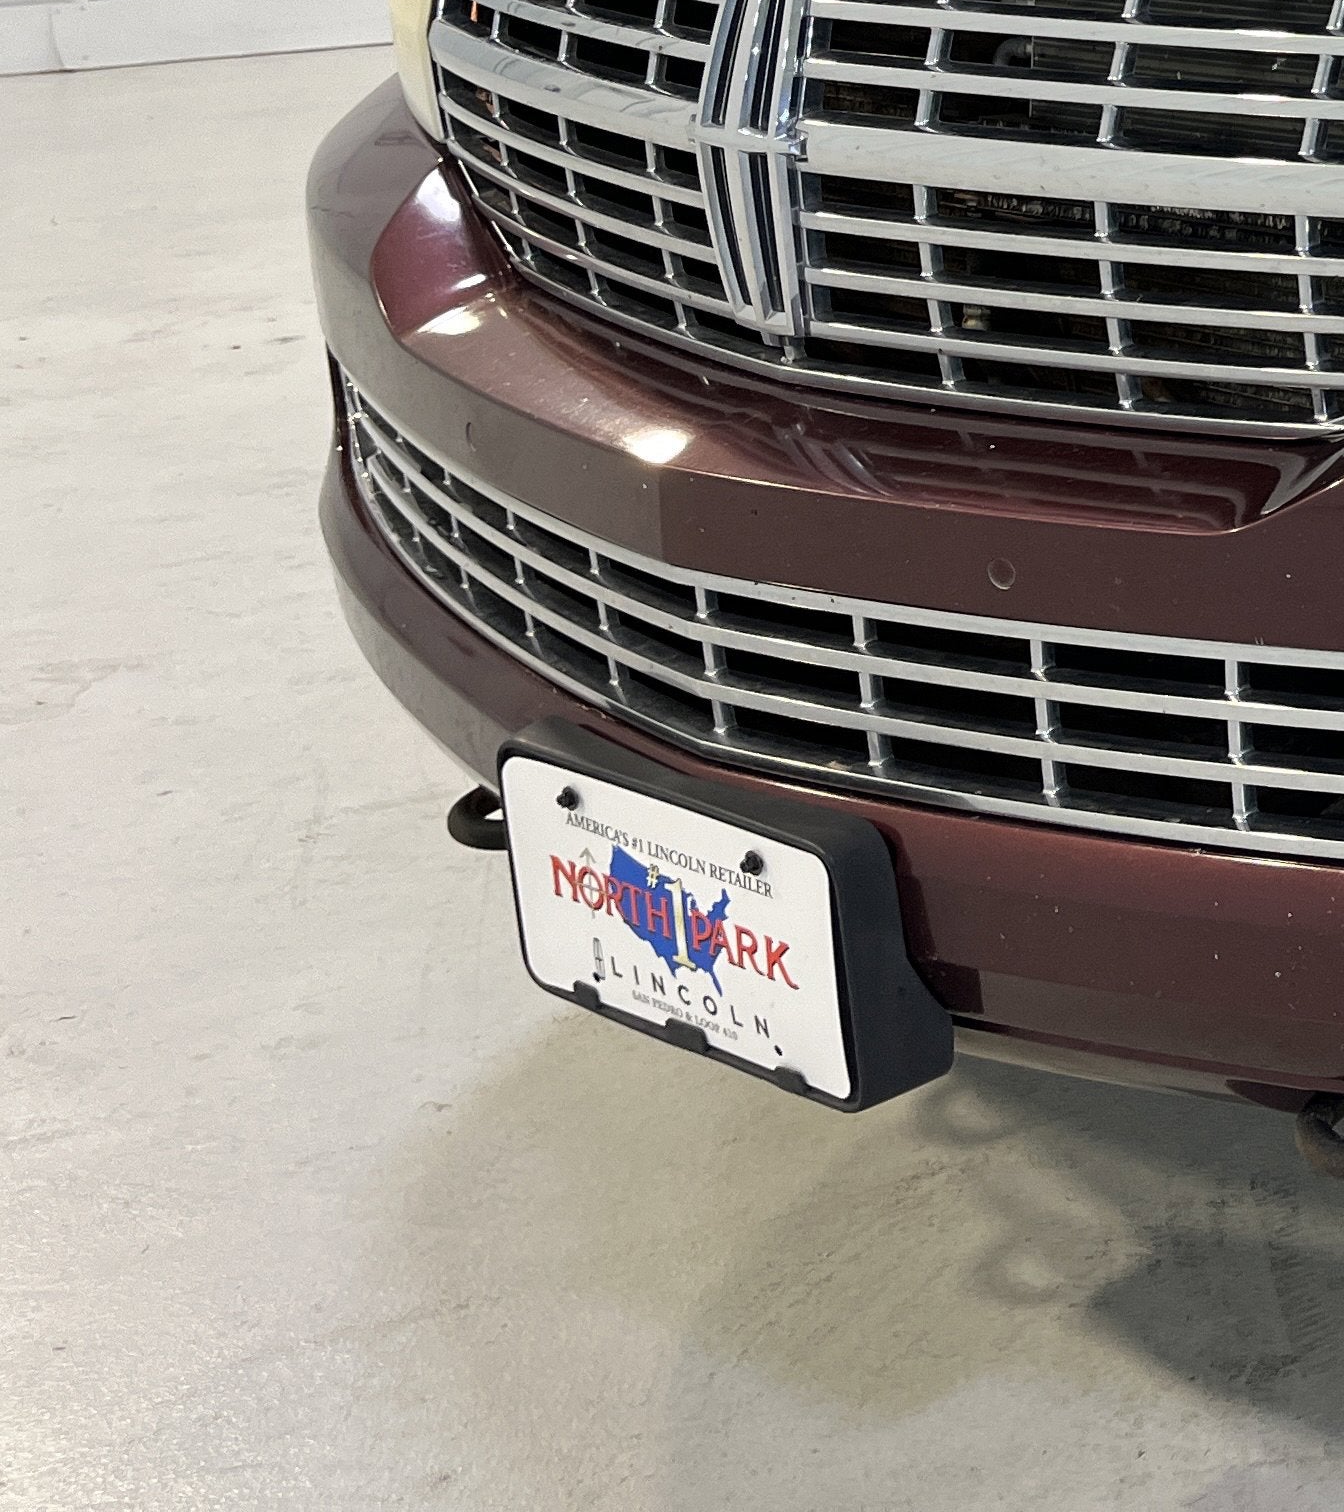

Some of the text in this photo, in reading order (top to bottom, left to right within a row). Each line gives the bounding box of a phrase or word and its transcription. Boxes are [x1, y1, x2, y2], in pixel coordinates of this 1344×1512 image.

[565, 811, 773, 900] AMERICA'S #1 LINCOLN RETAILER
[550, 854, 800, 990] NORTH PARK
[611, 955, 770, 1039] LINCOLN
